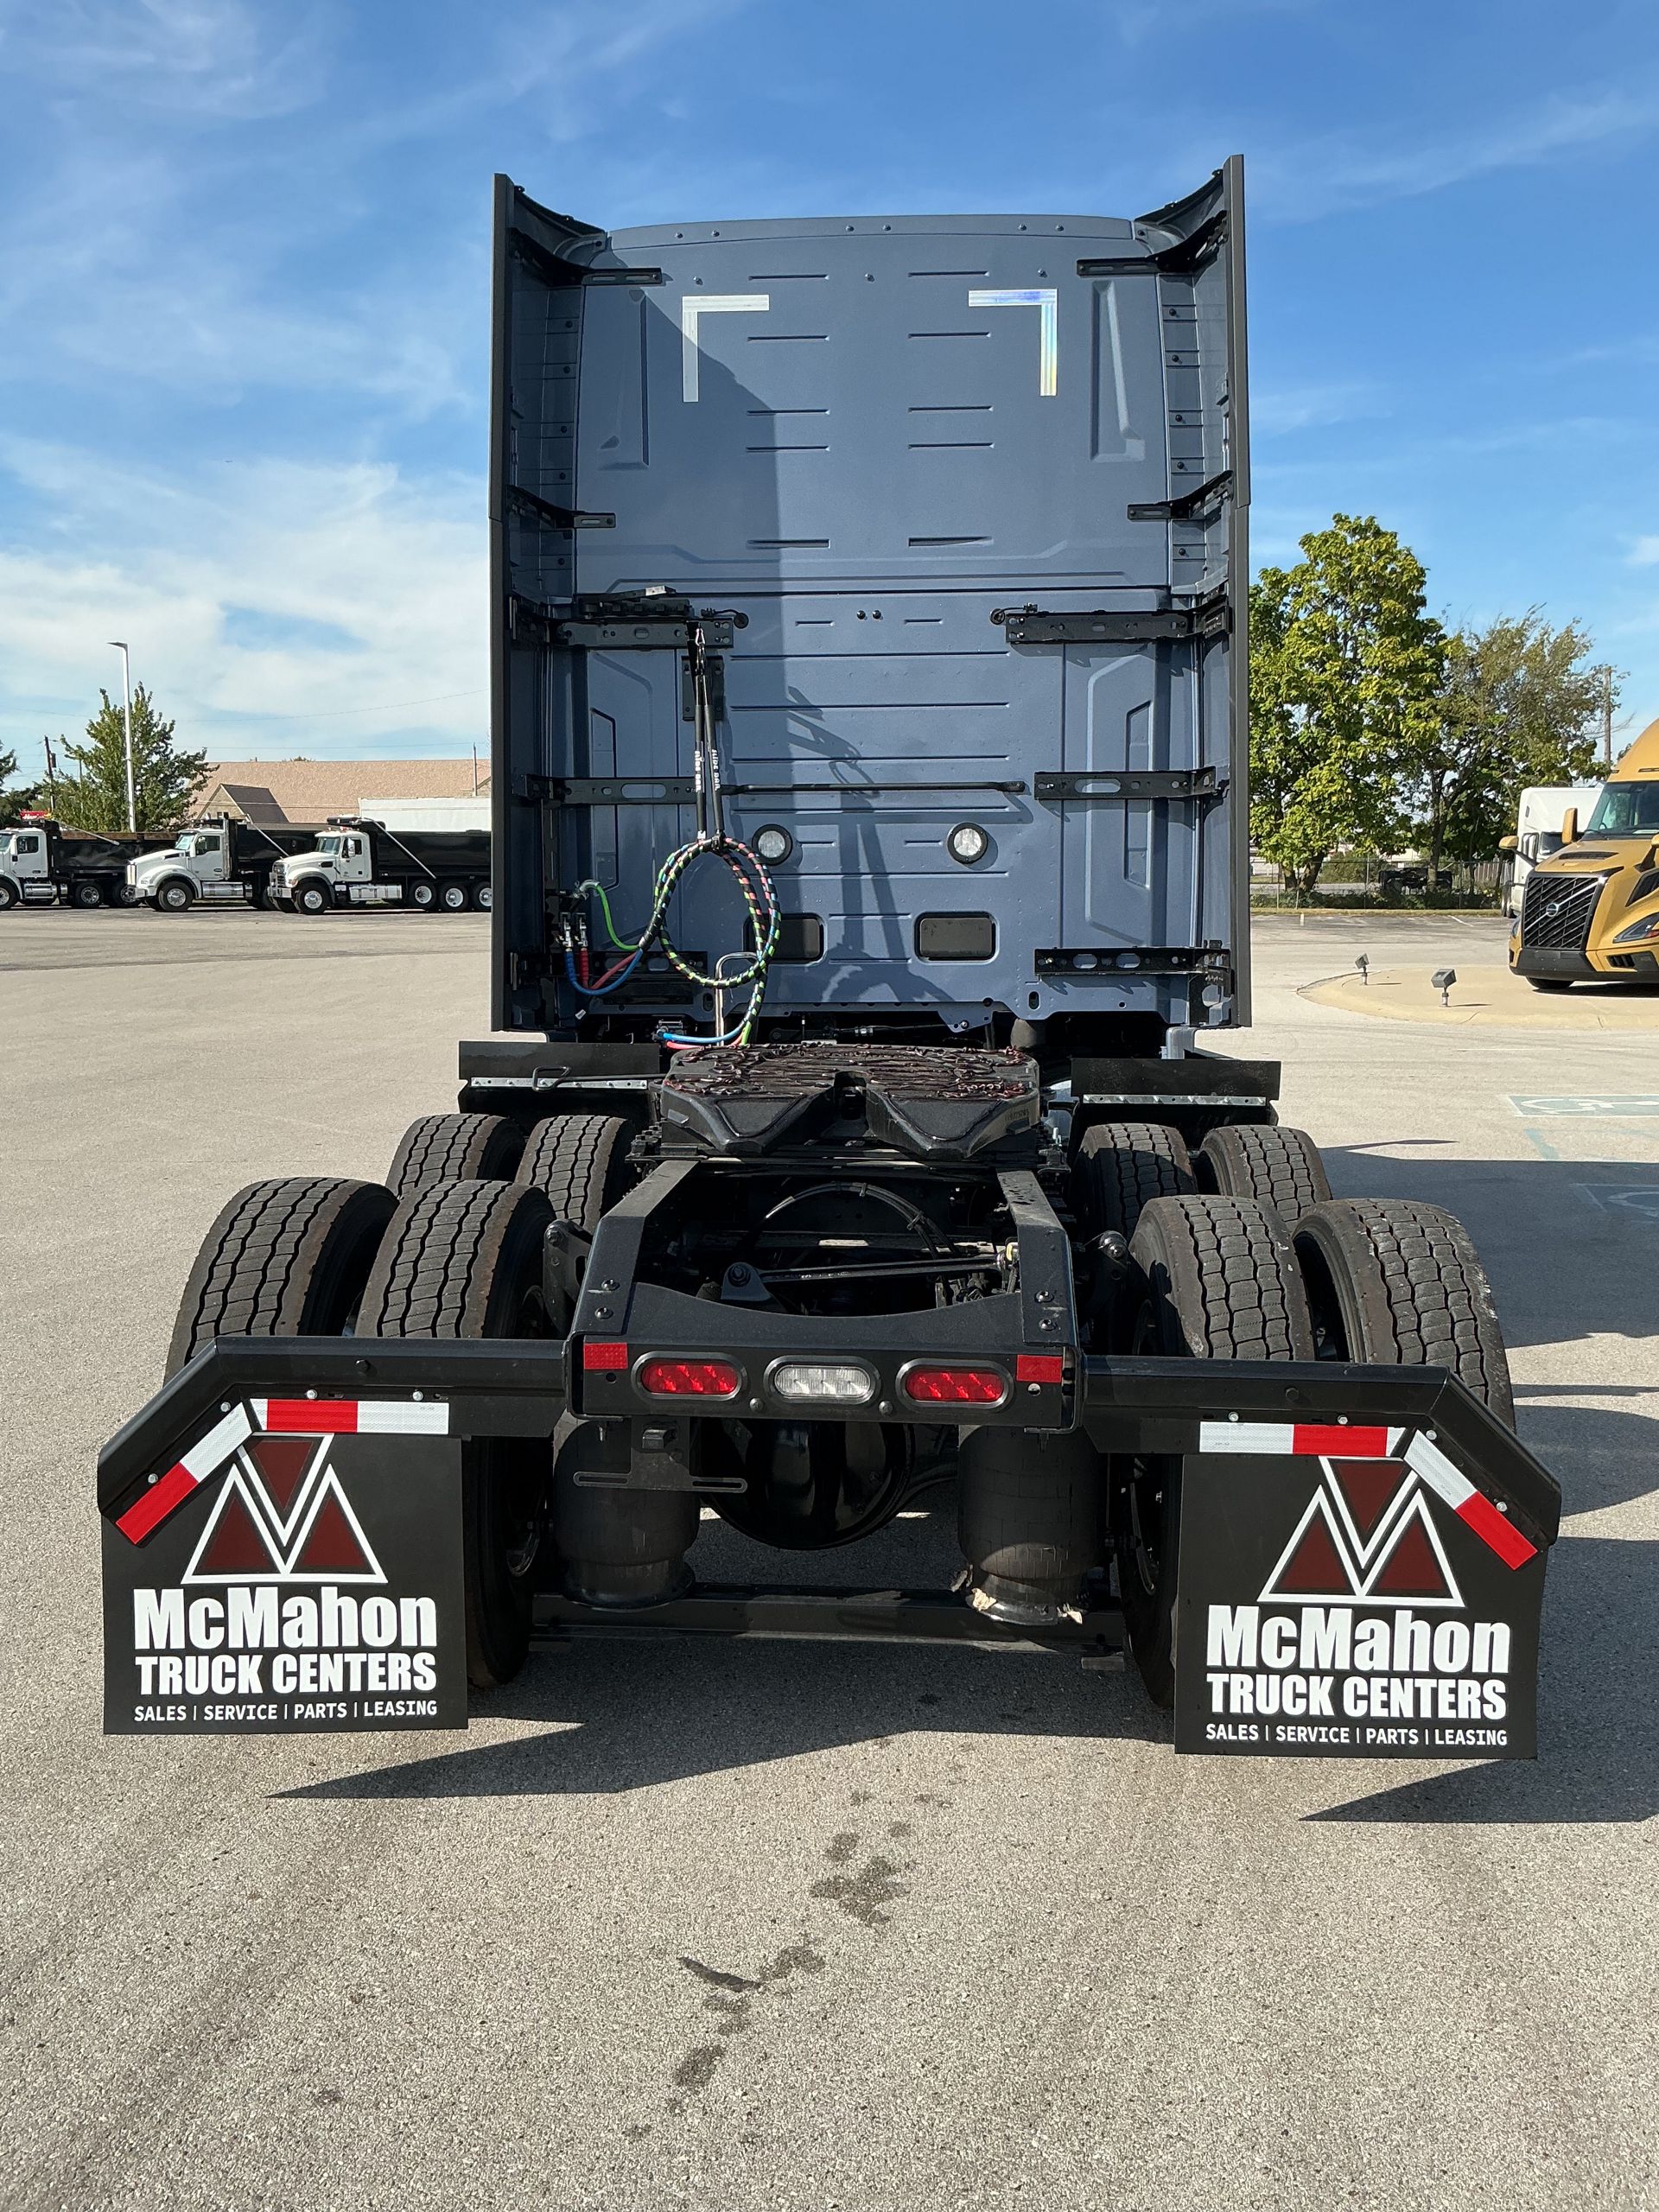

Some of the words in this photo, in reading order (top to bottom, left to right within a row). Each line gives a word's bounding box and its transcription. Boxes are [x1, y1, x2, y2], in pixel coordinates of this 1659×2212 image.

[133, 1586, 437, 1650] McMahon
[1206, 1604, 1510, 1674] McMahon
[135, 1654, 264, 1695] TRUCK
[271, 1651, 437, 1694] CENTERS
[134, 1705, 187, 1722] SALES
[203, 1704, 278, 1721] SERVICE
[294, 1702, 347, 1719] PARTS
[363, 1700, 437, 1718] LEASING
[1206, 1673, 1335, 1716] TRUCK
[1343, 1675, 1507, 1720] CENTERS
[1205, 1723, 1259, 1741] SALES
[1275, 1725, 1351, 1744] SERVICE
[1365, 1727, 1419, 1745] PARTS
[1434, 1728, 1508, 1746] LEASING
